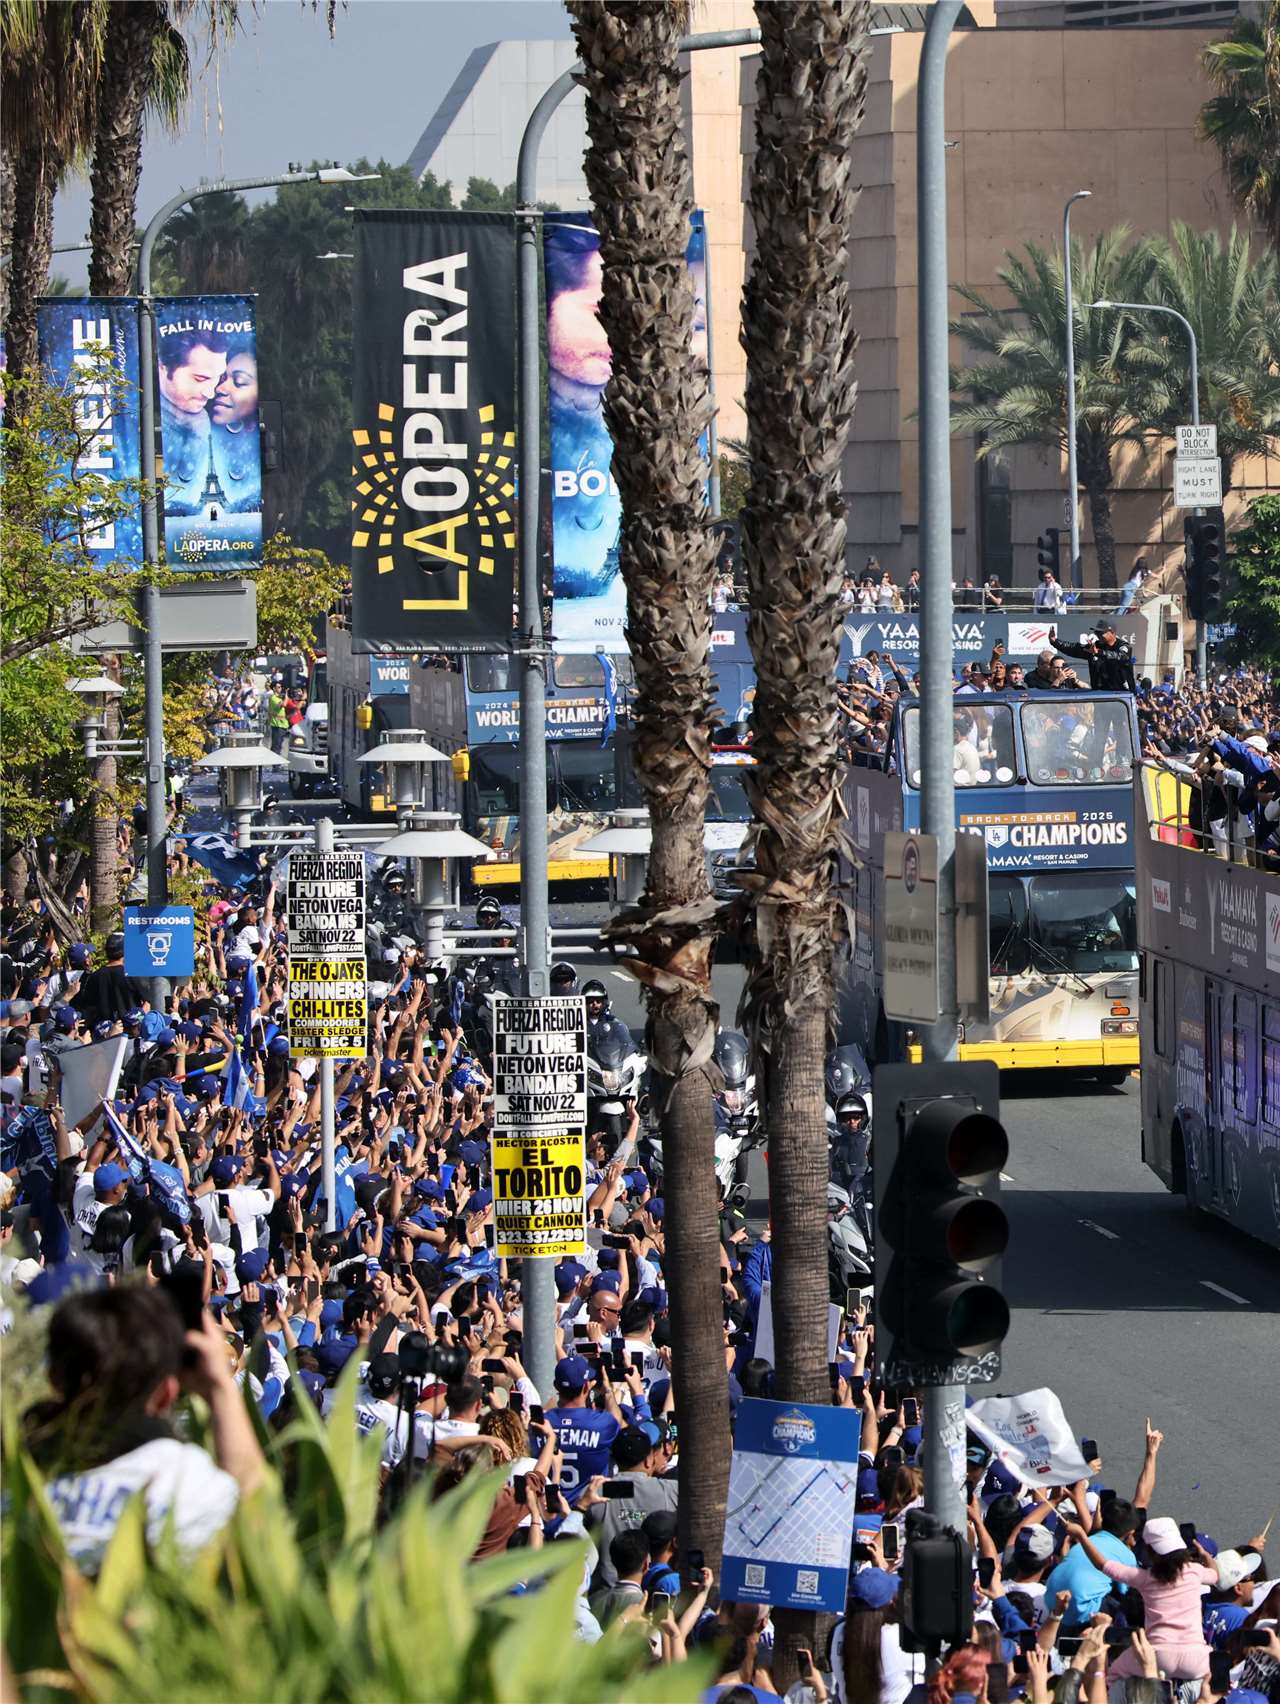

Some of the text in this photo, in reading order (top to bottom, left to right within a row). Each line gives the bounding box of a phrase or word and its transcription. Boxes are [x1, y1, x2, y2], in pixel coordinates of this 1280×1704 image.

[159, 319, 252, 337] FALL IN LOVE
[1181, 427, 1210, 438] DO NOT
[1184, 439, 1208, 448] BLOCK
[1183, 478, 1214, 487] MUST
[594, 618, 616, 627] NOV
[1082, 811, 1114, 821] 2025
[1010, 822, 1128, 848] CHAMPIONS
[289, 860, 363, 881] FUERZA REGIDA
[295, 881, 357, 898] FUTURE
[289, 899, 363, 915] NETON VEGA
[127, 916, 191, 926] RESTROOMS
[299, 930, 356, 943] SAT NOV 22
[291, 962, 316, 980] THE
[290, 981, 365, 1000] SPINNERS
[292, 1001, 364, 1018] CHI-LITES
[294, 1019, 361, 1027] COMMODORES
[496, 1008, 584, 1033] FUERZA REGIDA
[291, 1027, 364, 1036] SISTER SLEDGE
[294, 1036, 362, 1048] FRI DEC 5
[505, 1034, 577, 1054] FUTURE
[303, 1048, 352, 1057] ticketmaster
[498, 1055, 584, 1074] NETON VEGA
[508, 1095, 575, 1112] SAT NOV 22
[496, 1137, 580, 1148] HECTOR ACOSTA
[522, 1149, 554, 1167] EL
[495, 1164, 582, 1198] TORITO
[496, 1198, 584, 1216] MIER 26 NOV
[496, 1214, 583, 1230] QUIET CANNON
[497, 1228, 584, 1244] 323.337.2299
[513, 1244, 567, 1255] TICKETON
